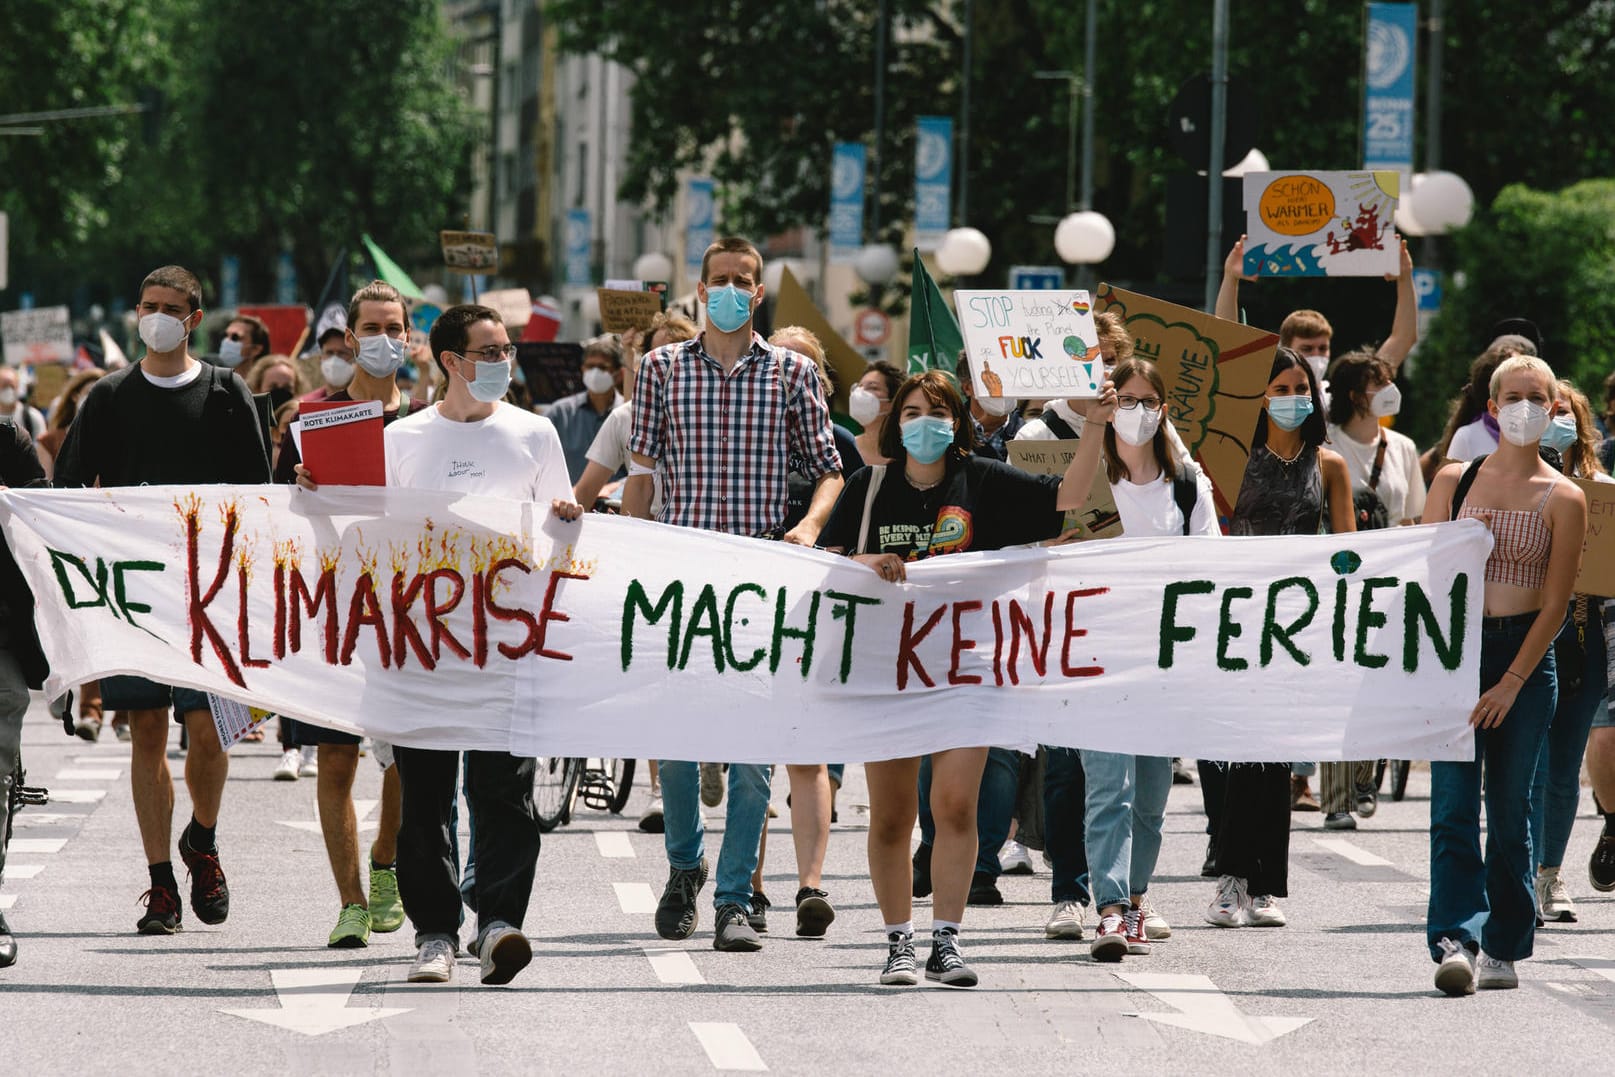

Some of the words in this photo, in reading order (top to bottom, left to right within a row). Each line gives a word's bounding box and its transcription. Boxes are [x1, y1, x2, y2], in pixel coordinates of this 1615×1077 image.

[969, 296, 1013, 328] STOP
[998, 335, 1043, 360] FUCK
[304, 417, 324, 428] ROTE
[325, 409, 373, 426] KLIMAKARTE
[1020, 452, 1046, 463] WHAT
[879, 525, 890, 535] BE
[892, 524, 920, 533] KIND
[880, 533, 912, 543] EVERY
[46, 546, 167, 632] DIE
[184, 508, 592, 689] KLIMAKRISE
[621, 579, 882, 684] MACHT
[896, 587, 1110, 691] KEINE
